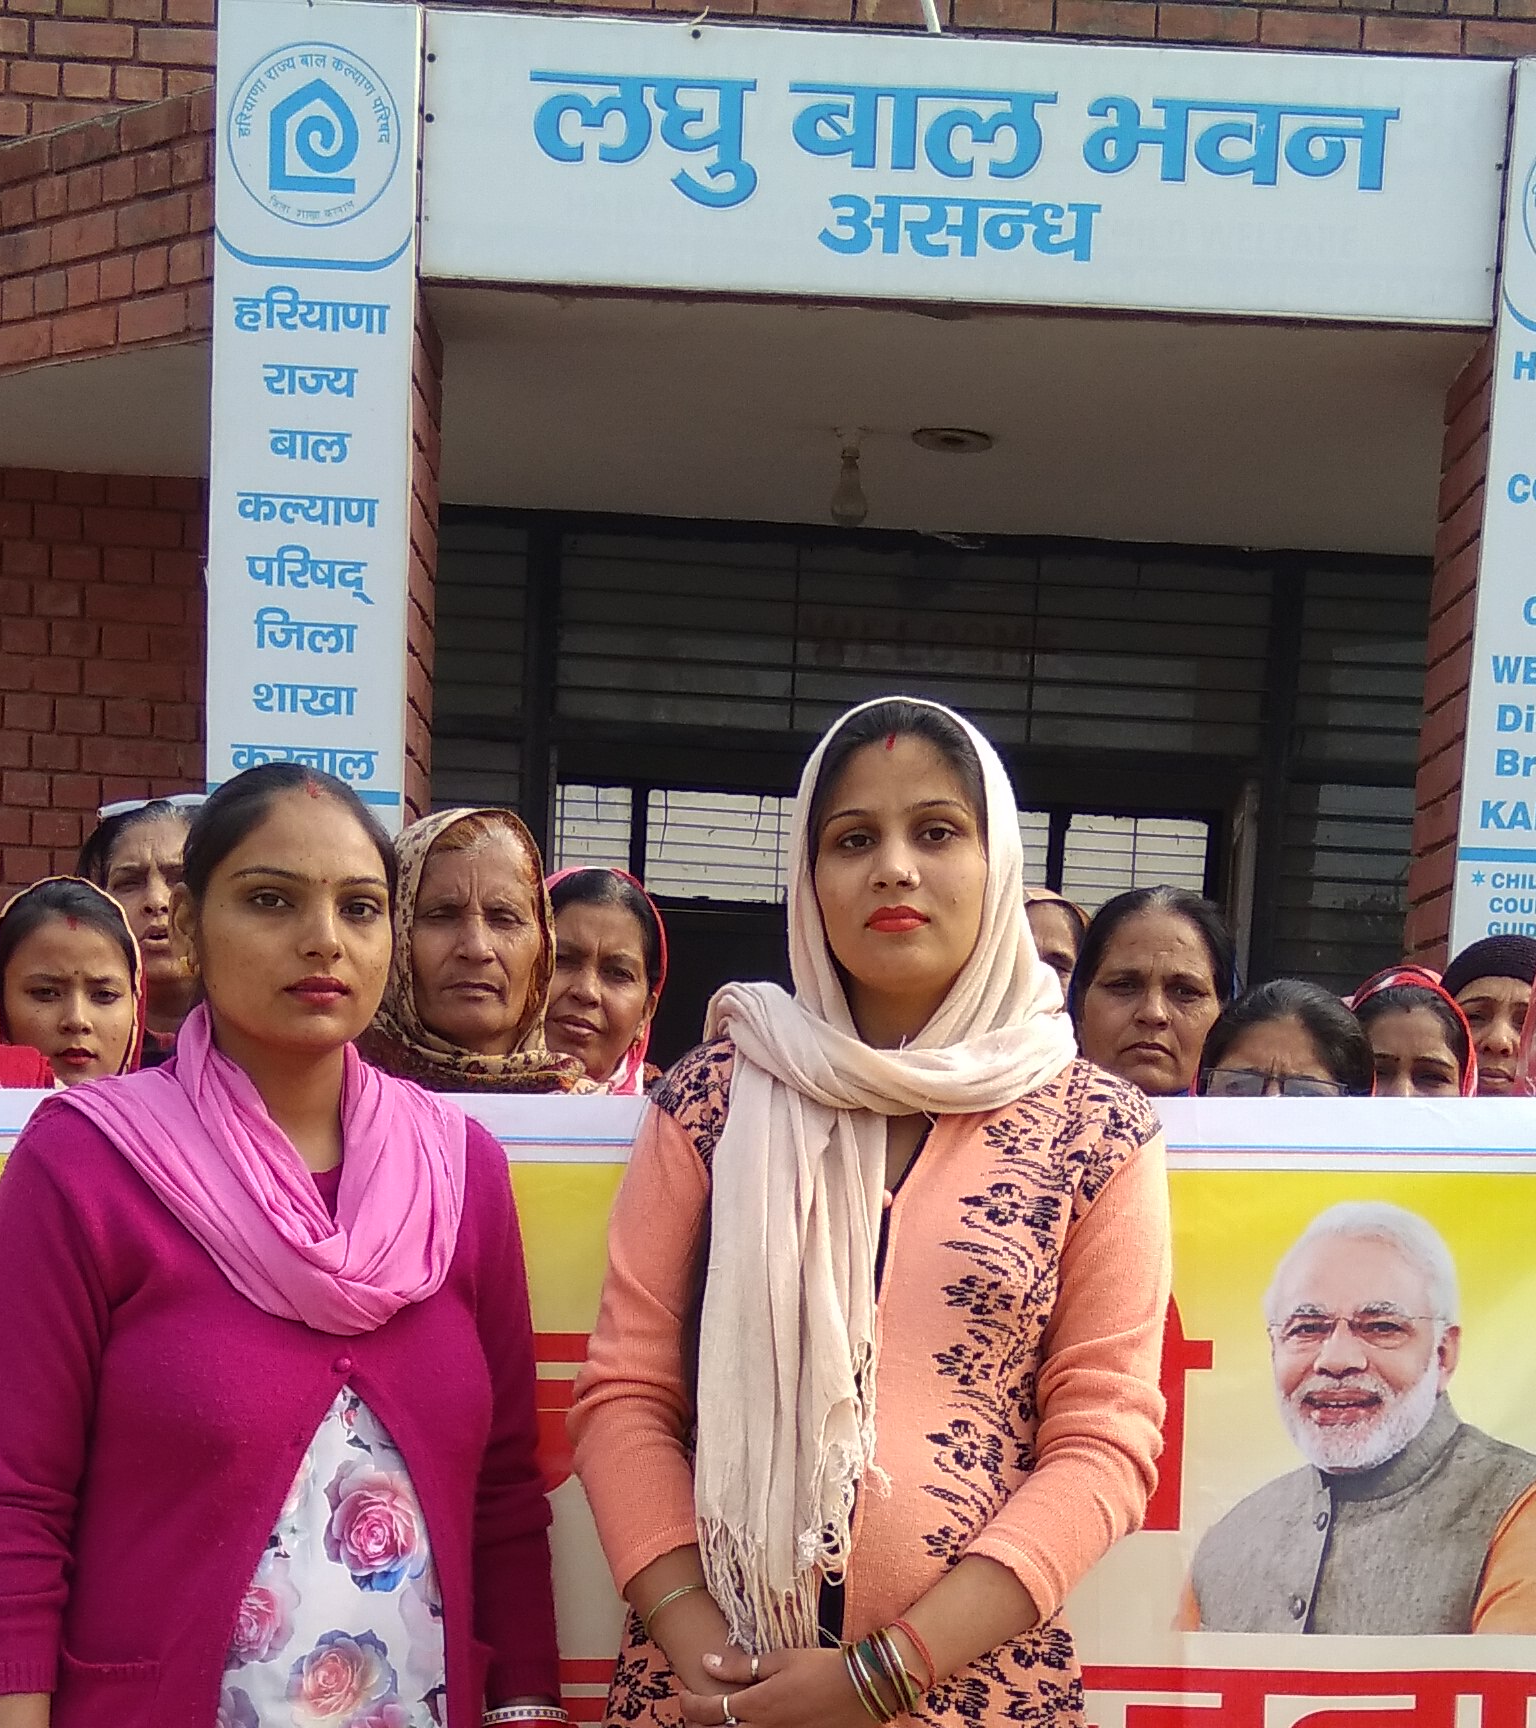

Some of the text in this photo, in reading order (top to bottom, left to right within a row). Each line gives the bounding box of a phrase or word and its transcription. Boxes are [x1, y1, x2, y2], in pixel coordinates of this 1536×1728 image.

[234, 78, 267, 138] हरियाणा
[265, 57, 296, 80] राज्य
[299, 53, 328, 68] बाल
[332, 56, 376, 96] कल्याण
[529, 70, 1401, 208] लघु बाल भवन
[817, 193, 1102, 263] असन्ध
[233, 285, 390, 335] हरियाणा
[263, 363, 358, 398] राज्य
[269, 428, 352, 463] बाल
[237, 491, 379, 528] कल्याण
[246, 544, 374, 605] परिषद्
[254, 607, 358, 653] जिला
[252, 683, 358, 716] शाखा
